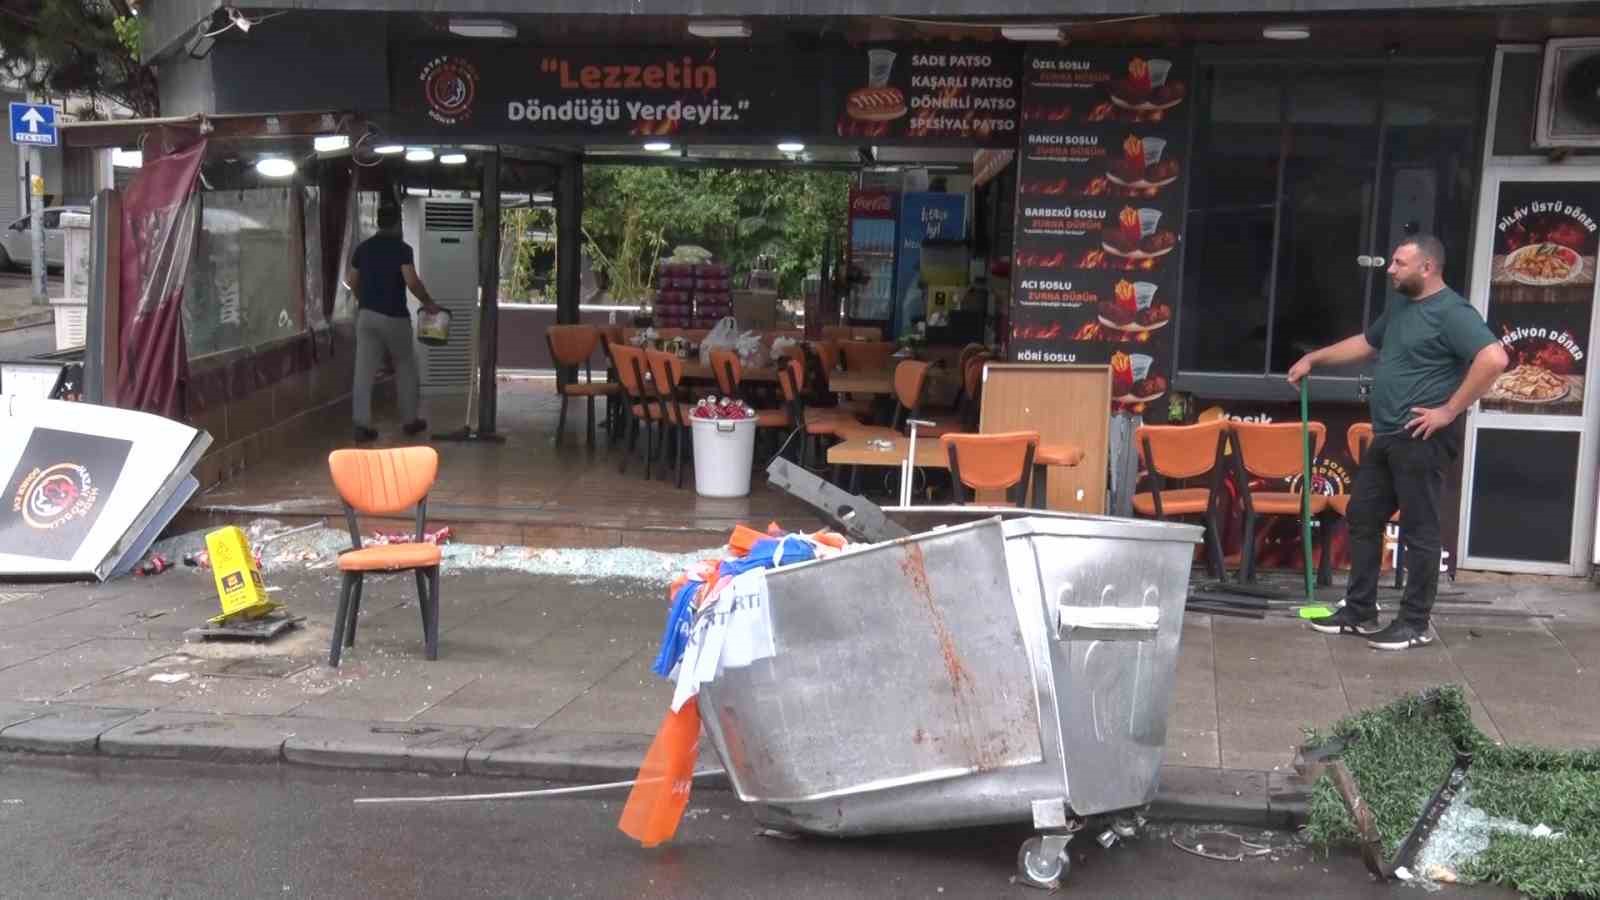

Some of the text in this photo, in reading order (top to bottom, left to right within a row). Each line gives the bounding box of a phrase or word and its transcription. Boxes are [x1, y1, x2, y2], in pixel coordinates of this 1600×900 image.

[911, 55, 992, 67] SADE PATSO
[1032, 59, 1091, 71] ÖZEL SOSLU
[911, 76, 1014, 90] KAŞARLI PATSO
[910, 95, 1016, 110] DÖNERLİ PATSO
[507, 98, 620, 125] Döndüğü
[910, 116, 1016, 131] SPESİYAL PATSO
[1065, 135, 1098, 145] SOSLU
[1073, 208, 1107, 219] SOSLU
[1531, 199, 1562, 213] ÜSTÜ
[1564, 205, 1597, 232] DÖNER
[1021, 280, 1072, 291] ACI SOSLU
[1549, 330, 1584, 361] DÖNER
[1017, 349, 1076, 363] KÖRİ SOSLU
